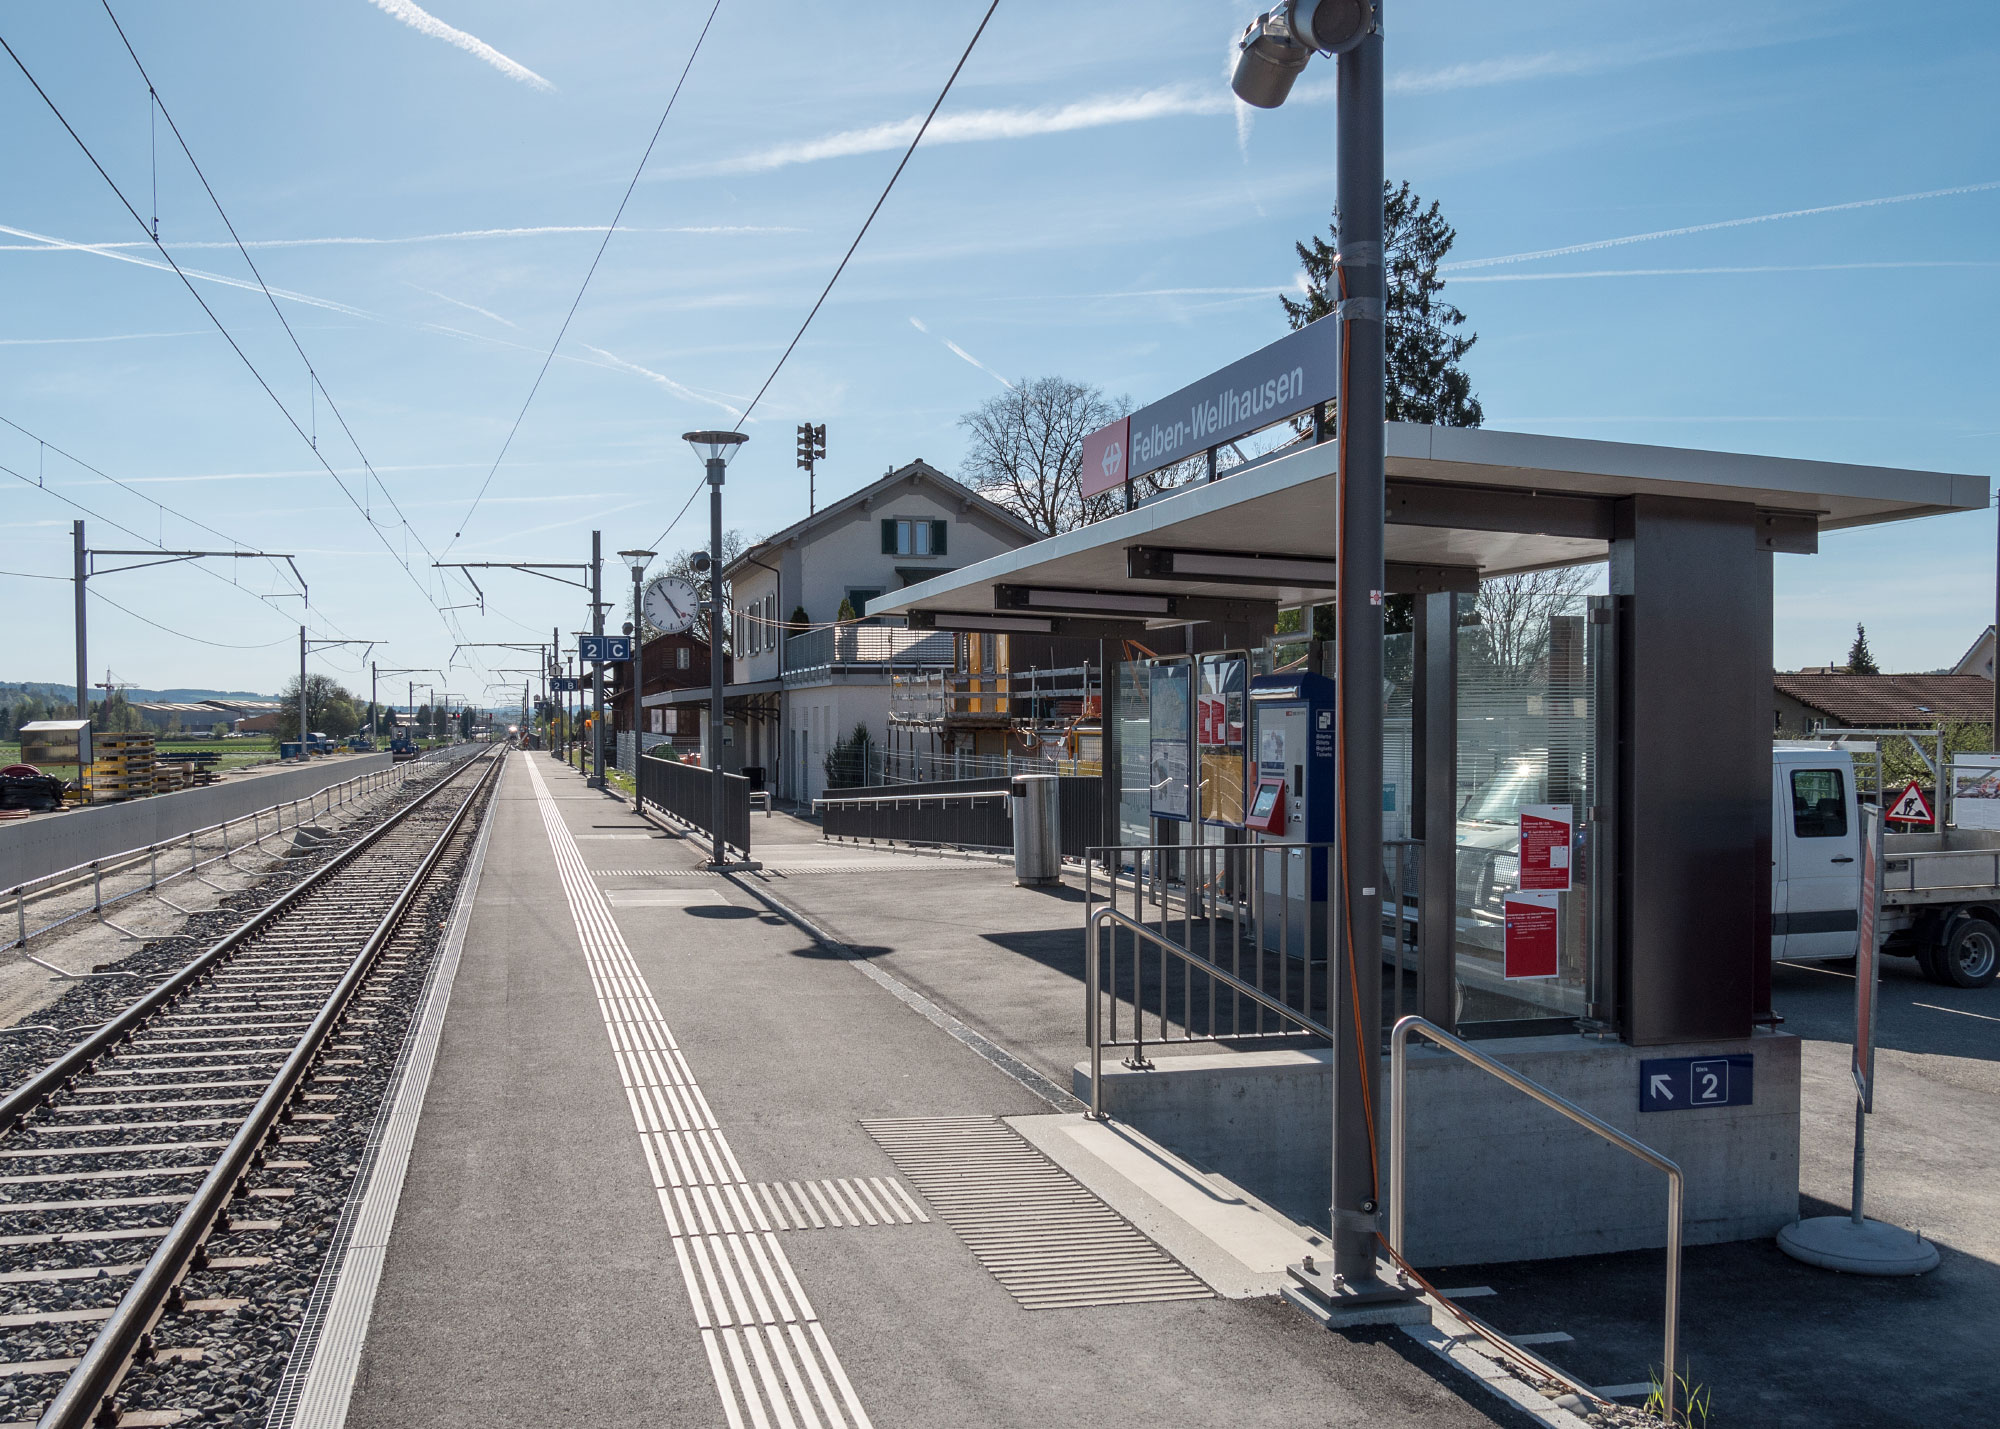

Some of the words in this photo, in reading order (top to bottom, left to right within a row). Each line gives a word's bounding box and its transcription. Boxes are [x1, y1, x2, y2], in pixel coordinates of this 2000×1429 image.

[1132, 366, 1303, 466] Felben-Wellhausen
[588, 644, 597, 657] 2
[612, 644, 624, 657] C
[553, 667, 557, 675] 1
[1702, 1073, 1718, 1099] 2
